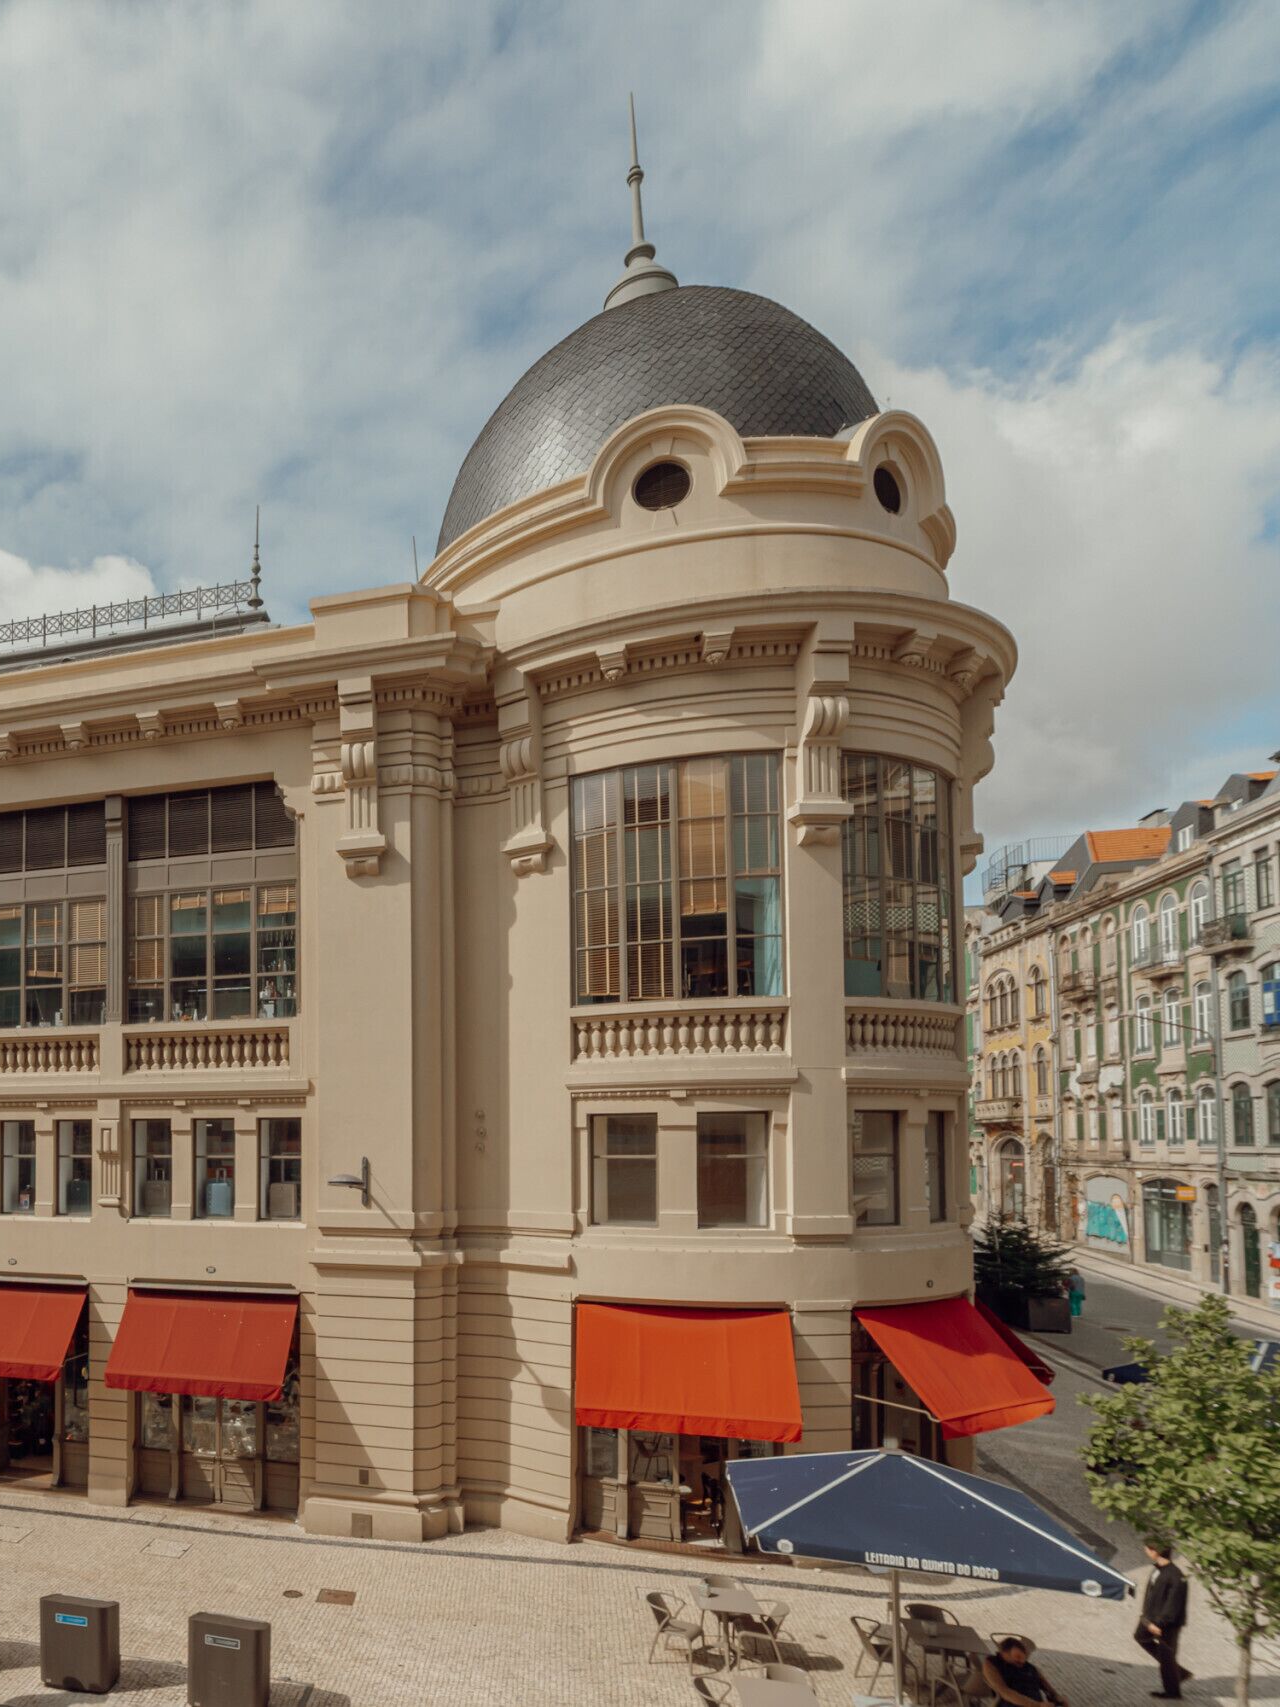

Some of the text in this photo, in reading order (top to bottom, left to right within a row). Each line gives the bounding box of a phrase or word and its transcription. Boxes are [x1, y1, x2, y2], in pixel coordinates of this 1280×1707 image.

[865, 1551, 999, 1580] LEITARIA DA QUINTA DO PAÇO
